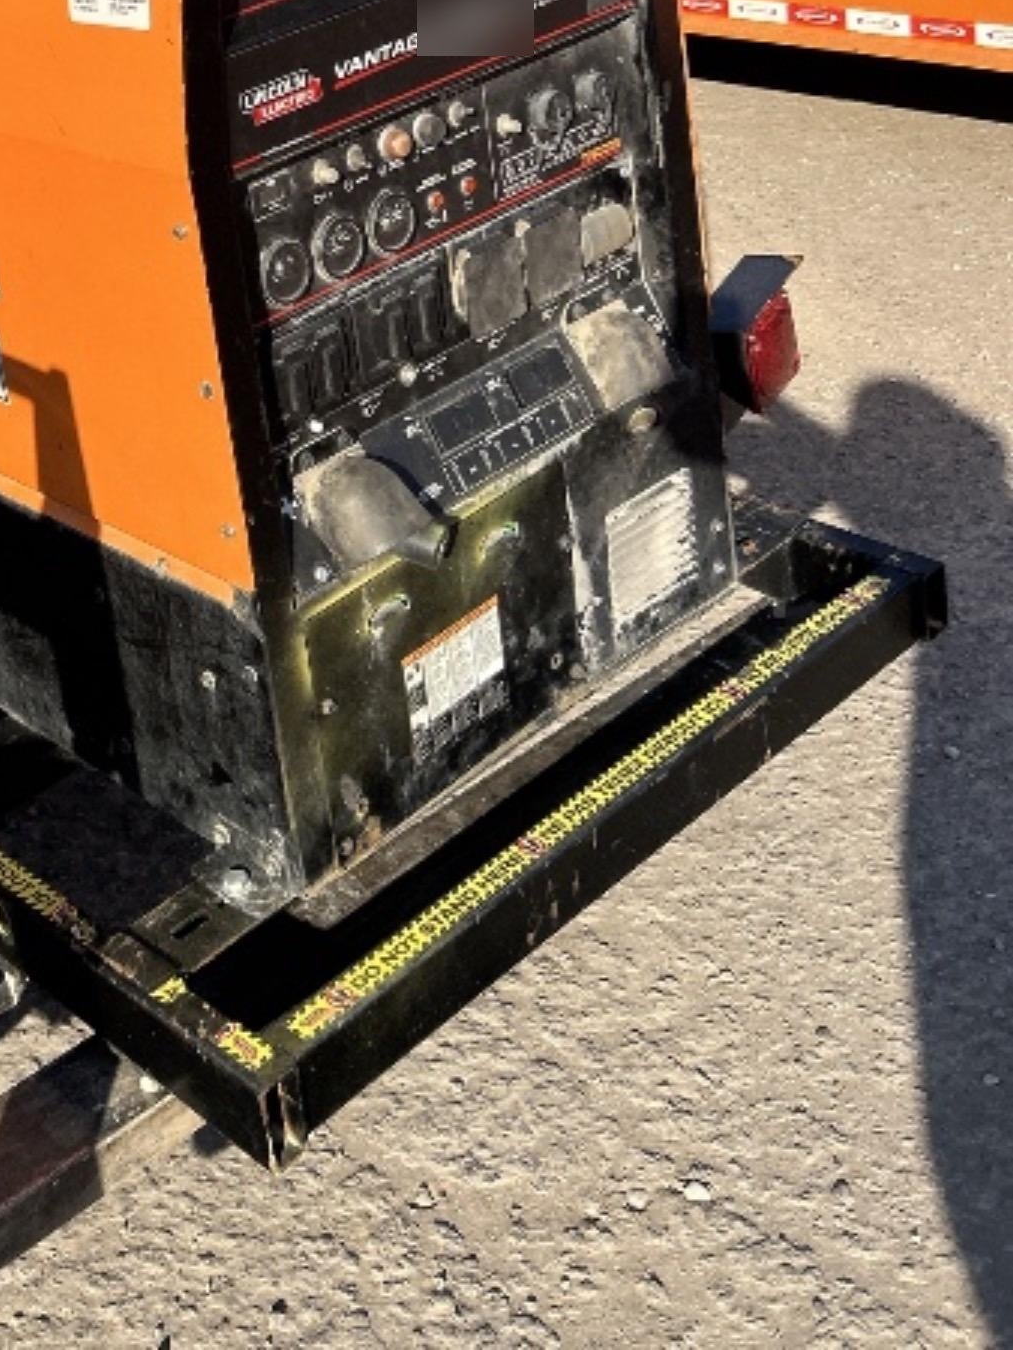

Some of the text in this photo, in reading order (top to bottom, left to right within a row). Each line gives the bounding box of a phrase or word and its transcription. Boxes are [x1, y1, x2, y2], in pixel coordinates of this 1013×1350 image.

[333, 32, 418, 80] VANTAG
[350, 964, 382, 989] DO
[380, 933, 419, 964] NOT
[420, 887, 478, 935] STAND
